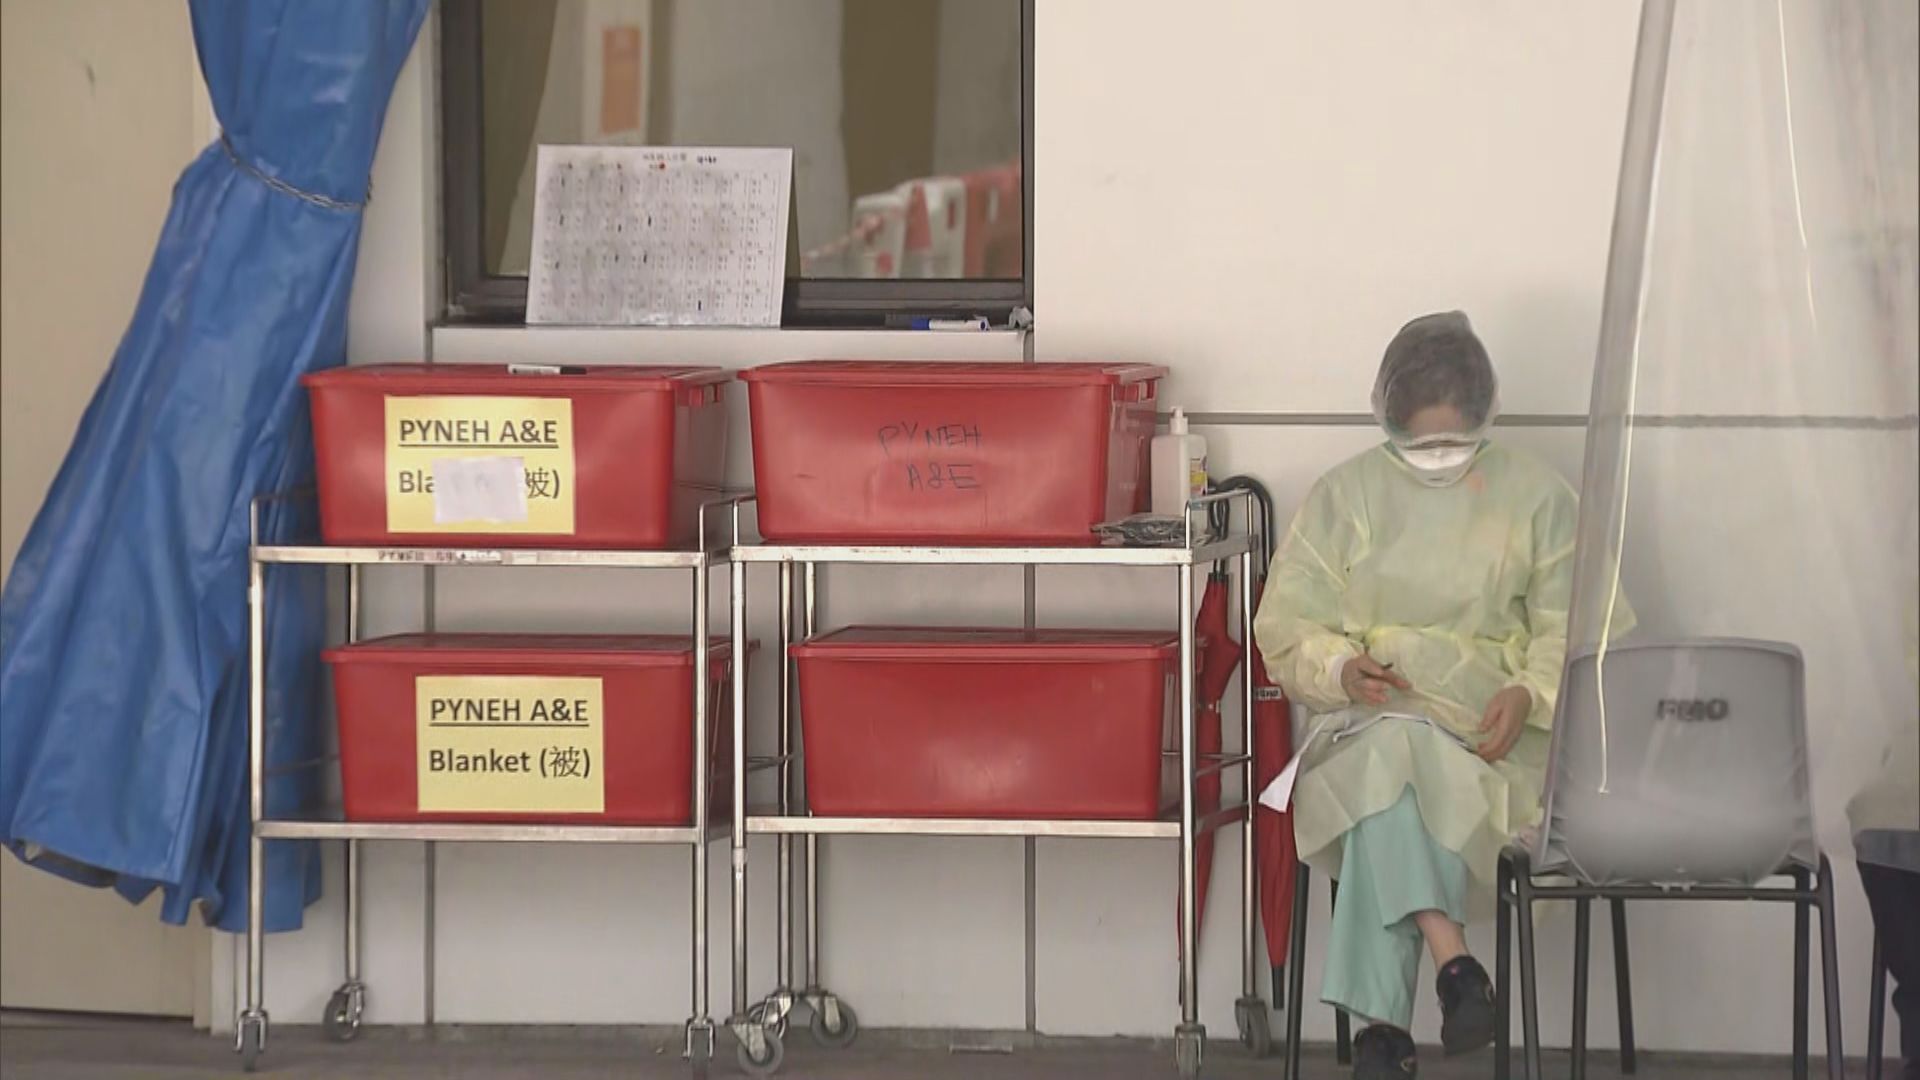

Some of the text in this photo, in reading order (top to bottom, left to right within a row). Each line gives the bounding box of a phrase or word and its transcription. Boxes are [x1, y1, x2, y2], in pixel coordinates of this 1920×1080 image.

[400, 420, 558, 443] PYNEH A&E
[878, 421, 982, 457] PYNEH
[907, 461, 981, 491] A&E
[430, 699, 589, 722] PYNEH A&E
[429, 746, 591, 779] Blanket (被)
